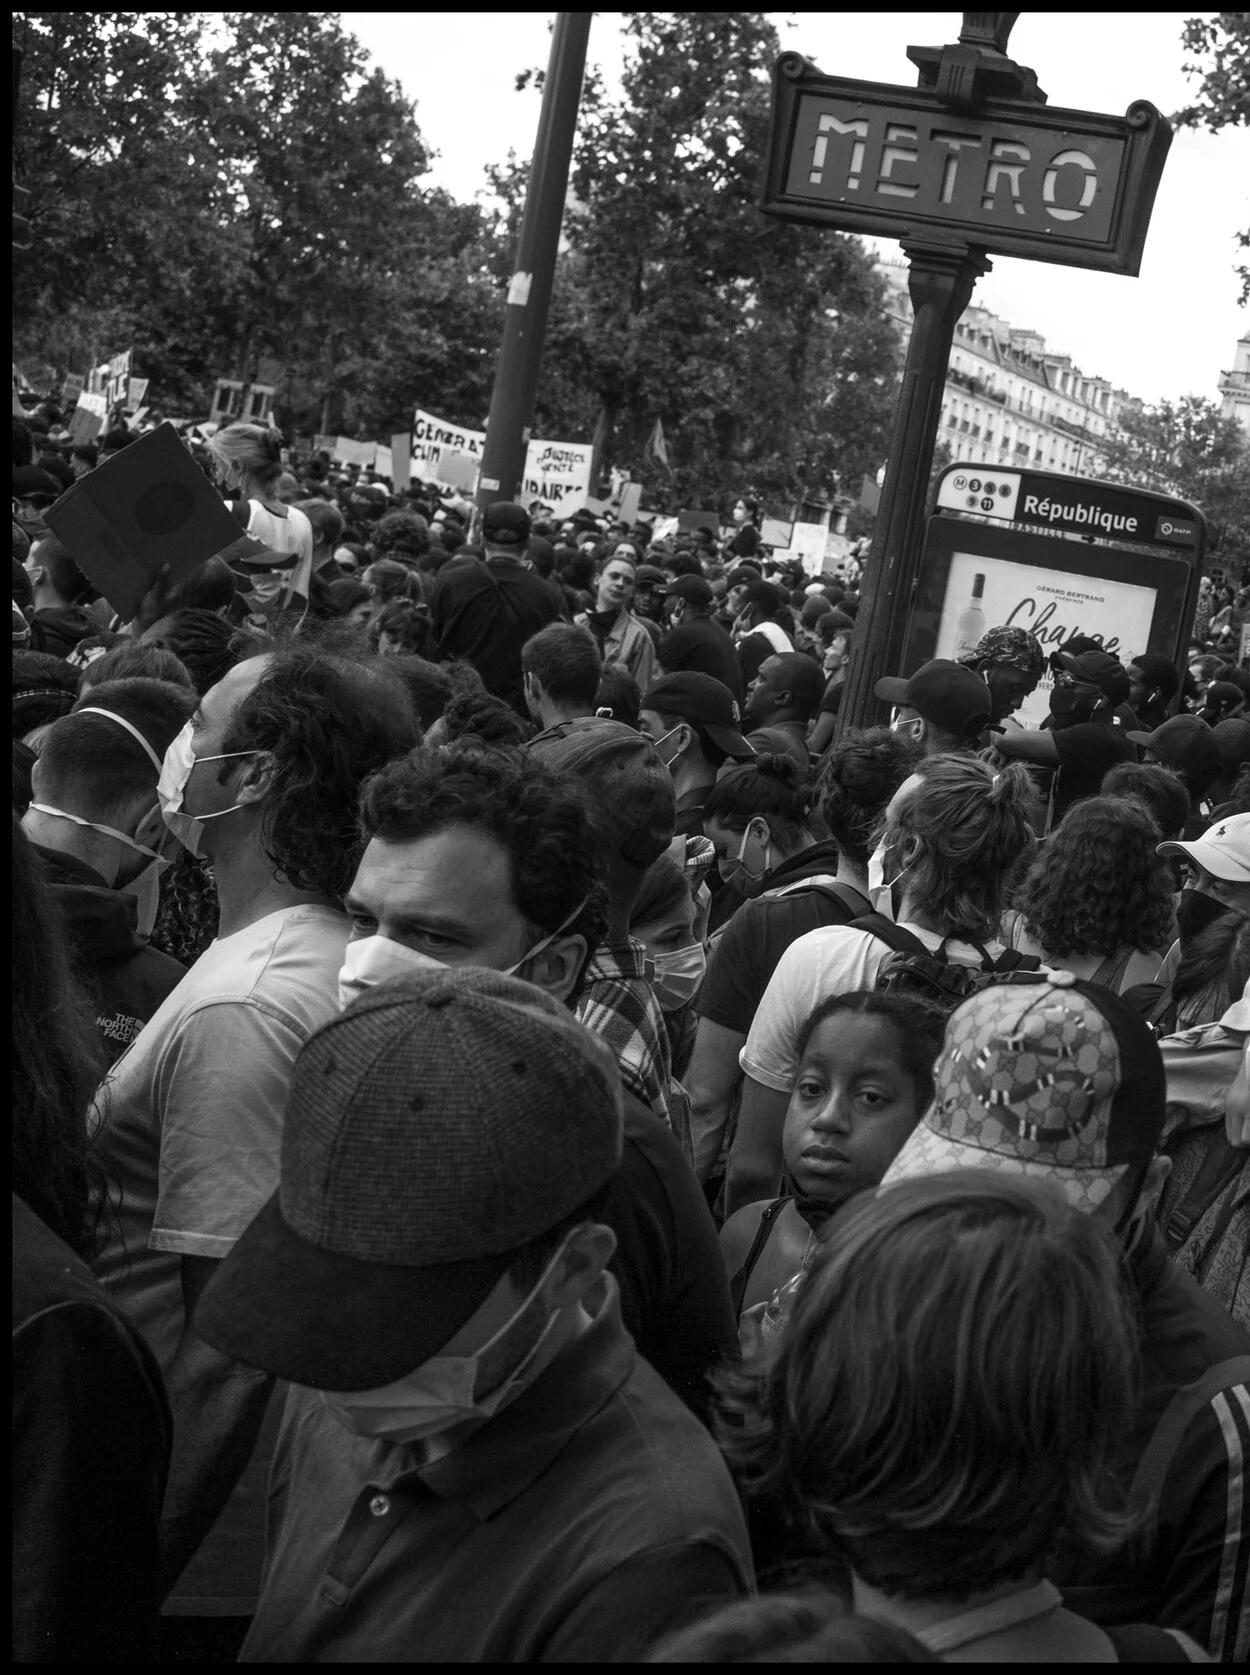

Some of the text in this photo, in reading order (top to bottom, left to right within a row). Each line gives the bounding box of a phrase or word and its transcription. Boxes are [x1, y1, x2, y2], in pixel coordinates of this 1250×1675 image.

[809, 112, 1098, 221] METRO
[1023, 495, 1138, 532] République
[1036, 584, 1105, 603] GÉRARD BERTRAND
[96, 1016, 134, 1034] NORTH
[115, 1012, 136, 1026] THE
[103, 1027, 131, 1043] FACE
